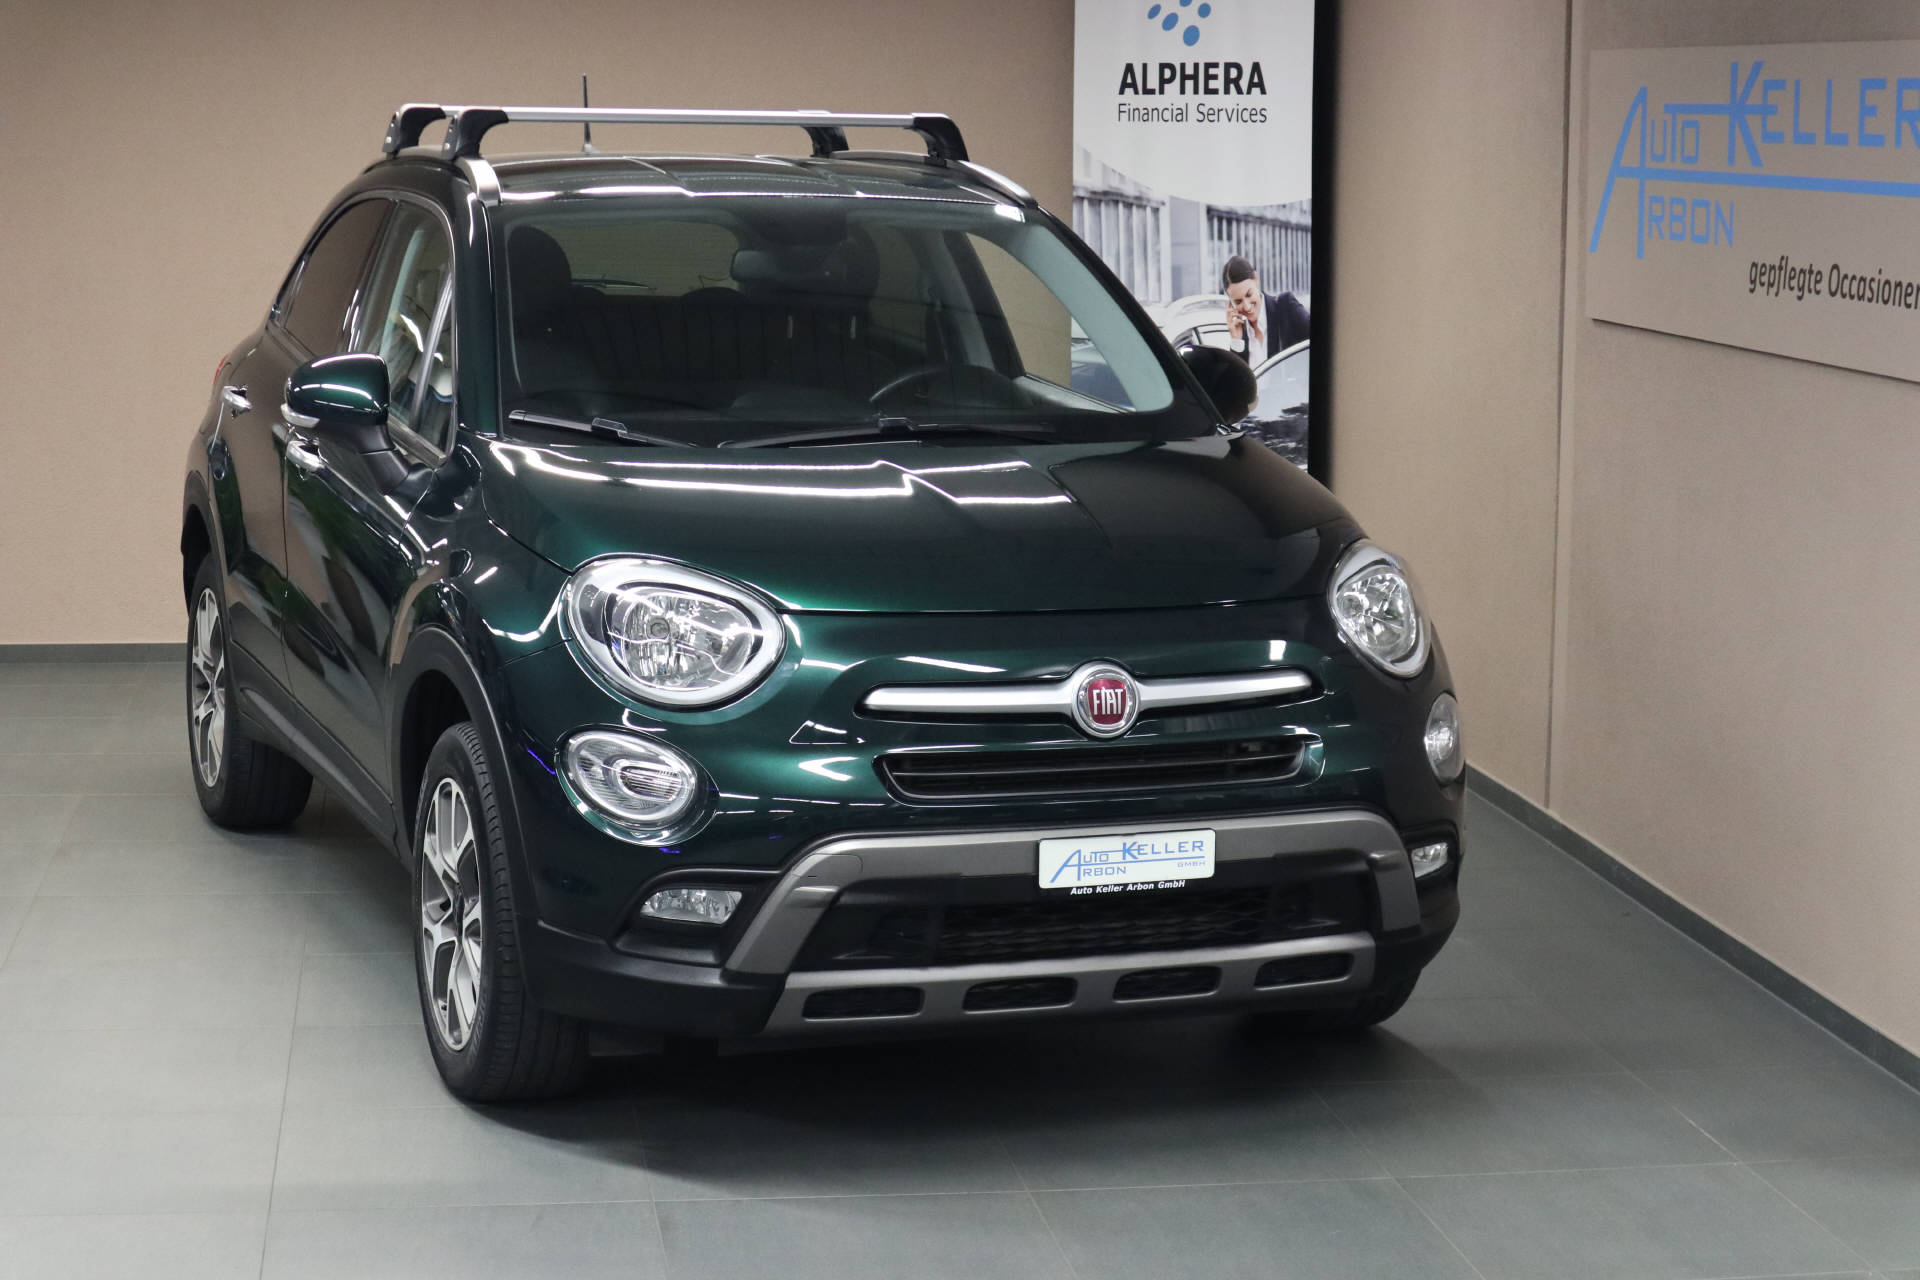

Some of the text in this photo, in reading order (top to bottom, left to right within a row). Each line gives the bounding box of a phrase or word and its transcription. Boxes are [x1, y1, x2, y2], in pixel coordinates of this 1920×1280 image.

[1118, 62, 1267, 95] ALPHERA
[1117, 103, 1267, 123] Financial Services
[1727, 60, 1920, 168] KELLER
[1749, 255, 1823, 301] gepflegte
[1092, 686, 1124, 716] FIAT
[1122, 841, 1204, 860] KELLER
[1070, 880, 1186, 896] Auto Keller Arbon GmbH
